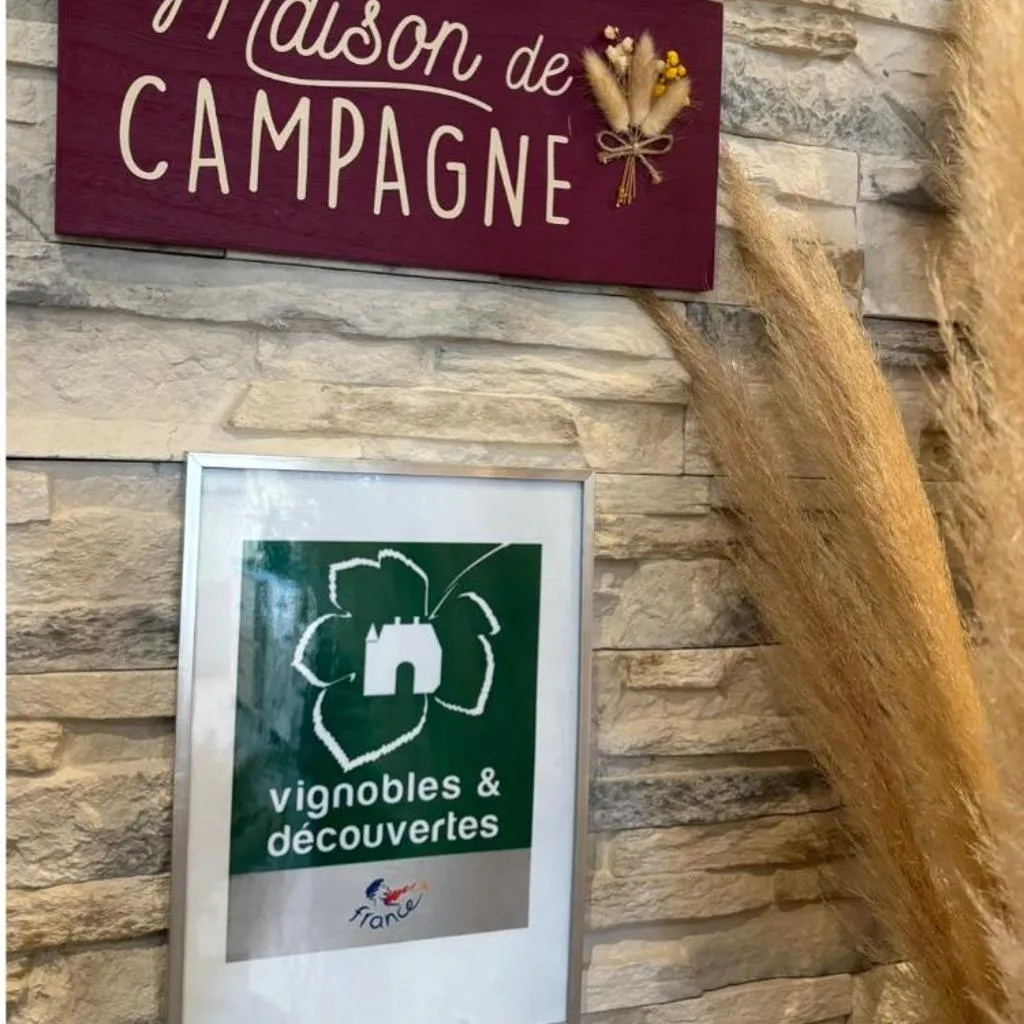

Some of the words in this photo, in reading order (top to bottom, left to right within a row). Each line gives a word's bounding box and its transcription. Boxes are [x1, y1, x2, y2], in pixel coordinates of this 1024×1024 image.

[506, 34, 574, 96] de
[118, 74, 572, 228] CAMPAGNE
[269, 772, 461, 819] vignobles
[477, 767, 501, 797] &
[267, 811, 499, 857] découvertes
